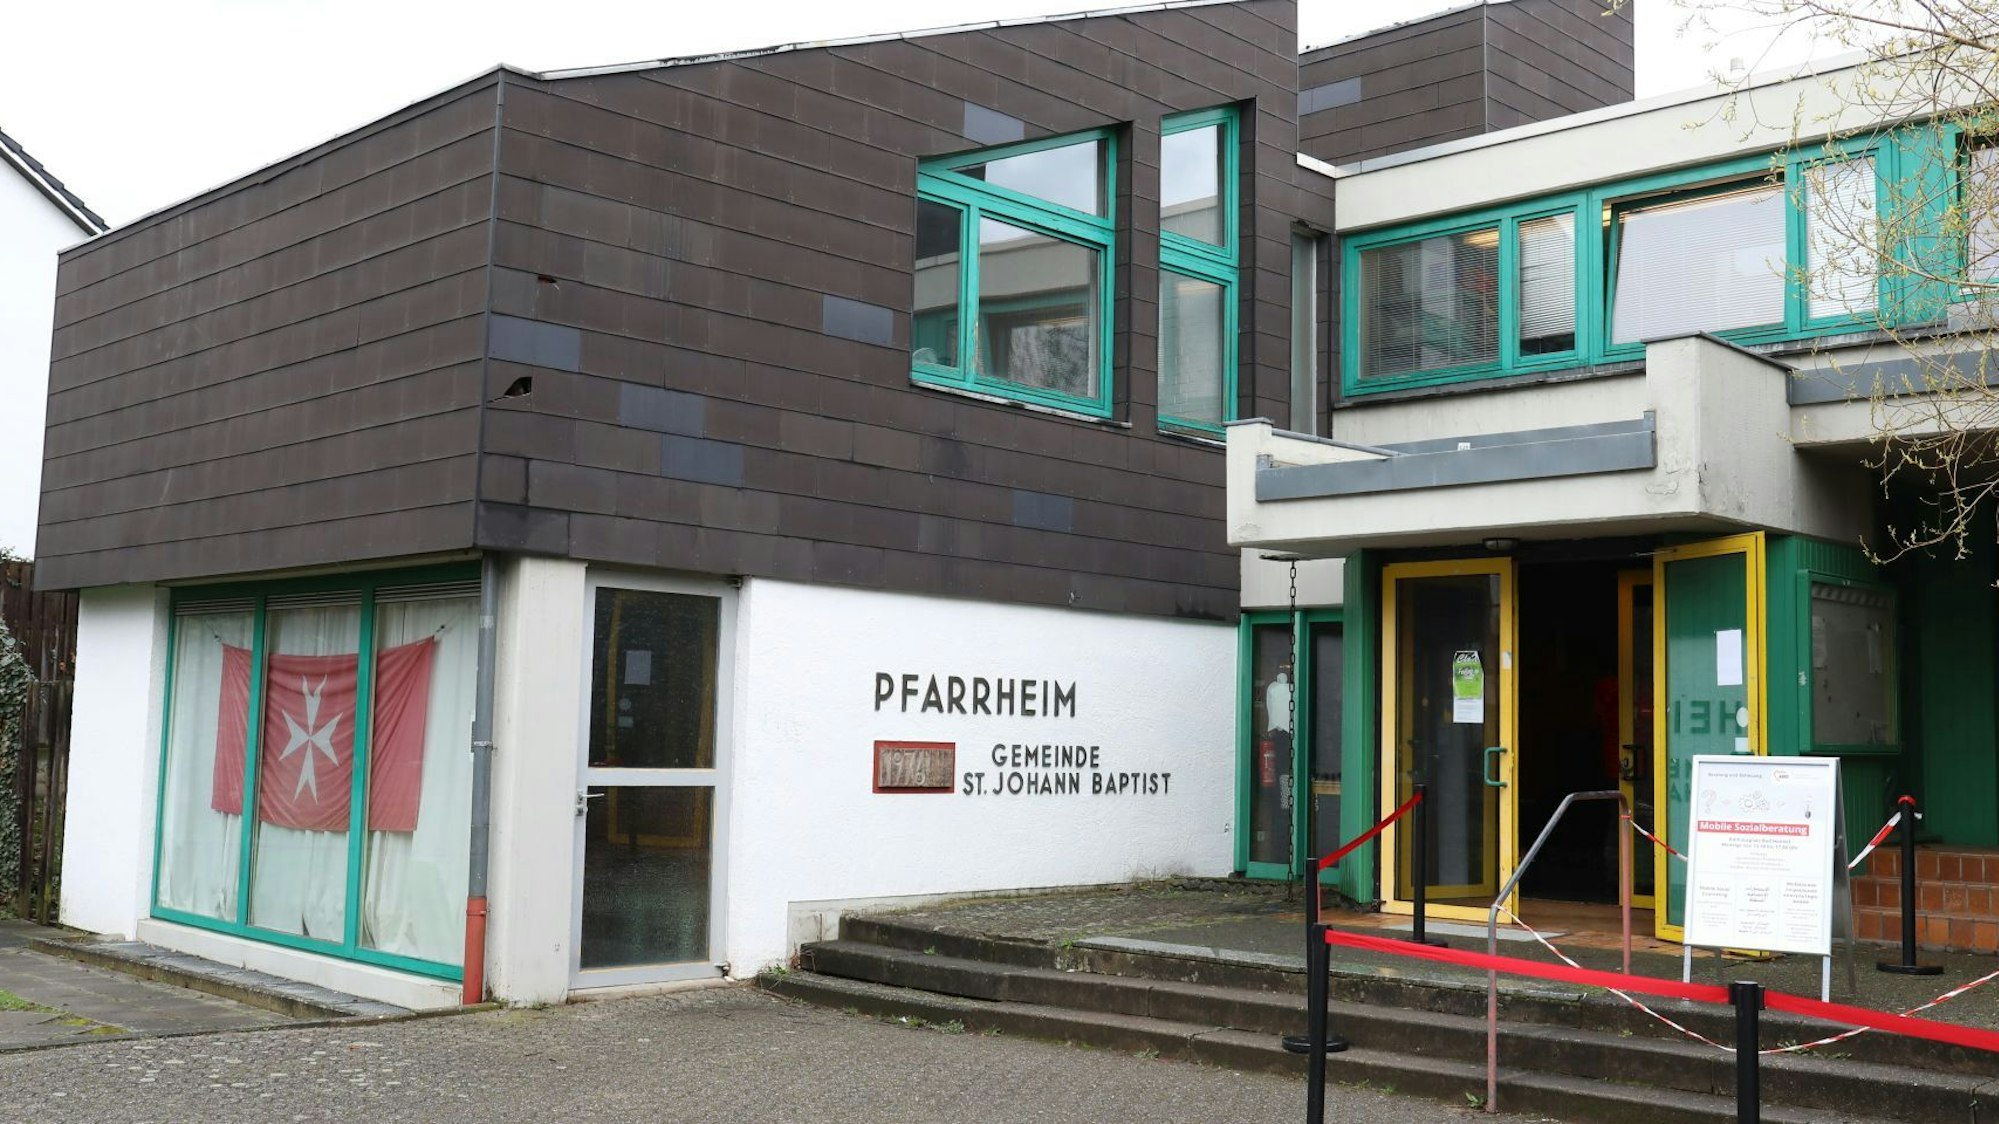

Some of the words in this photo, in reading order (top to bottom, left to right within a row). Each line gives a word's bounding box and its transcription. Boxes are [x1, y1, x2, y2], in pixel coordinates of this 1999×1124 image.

[874, 672, 1076, 718] PFARRHEIM
[991, 743, 1100, 769] GEMEINDE
[1092, 772, 1171, 795] BAPTIST
[1699, 821, 1732, 831] Mobile
[1734, 822, 1808, 836] Sozialberatung
